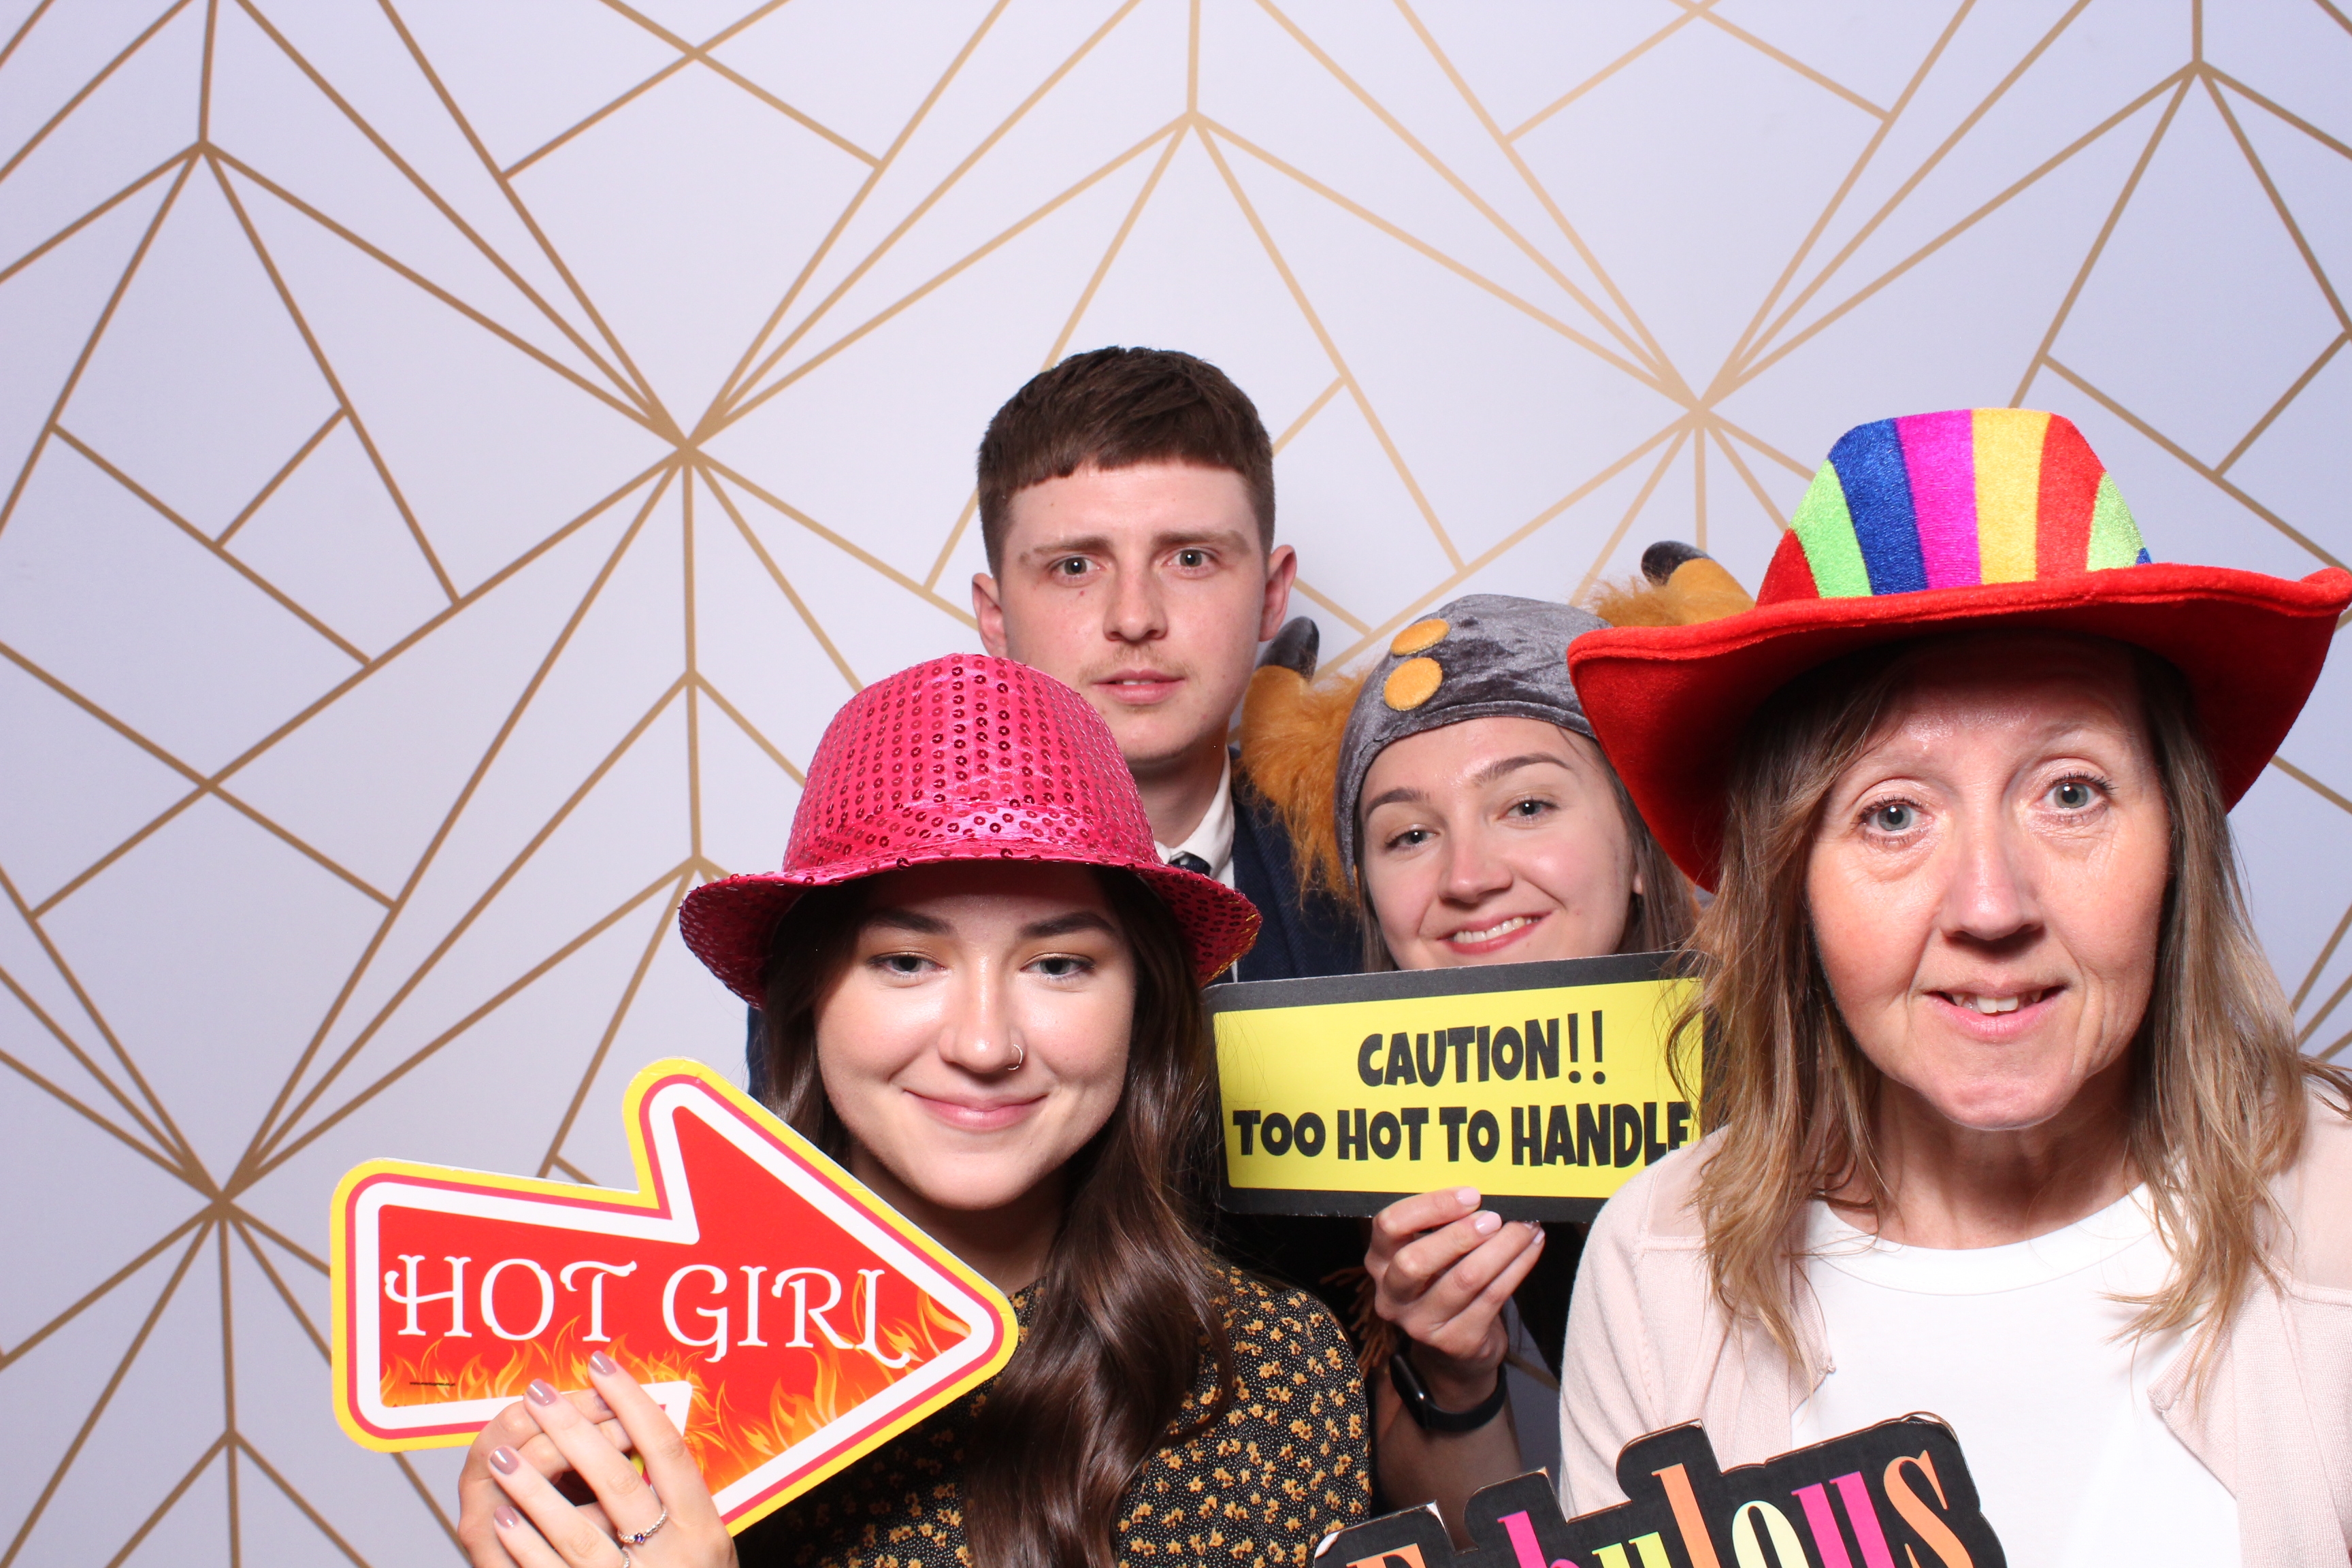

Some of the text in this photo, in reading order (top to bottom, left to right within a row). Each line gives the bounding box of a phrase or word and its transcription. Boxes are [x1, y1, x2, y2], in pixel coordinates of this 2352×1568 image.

[1357, 1009, 1606, 1088] CAUTION!!
[1232, 1109, 1326, 1157] TOO
[1337, 1107, 1429, 1161] HOT
[1439, 1106, 1500, 1162] TO
[385, 1254, 911, 1369] HOT GIRL
